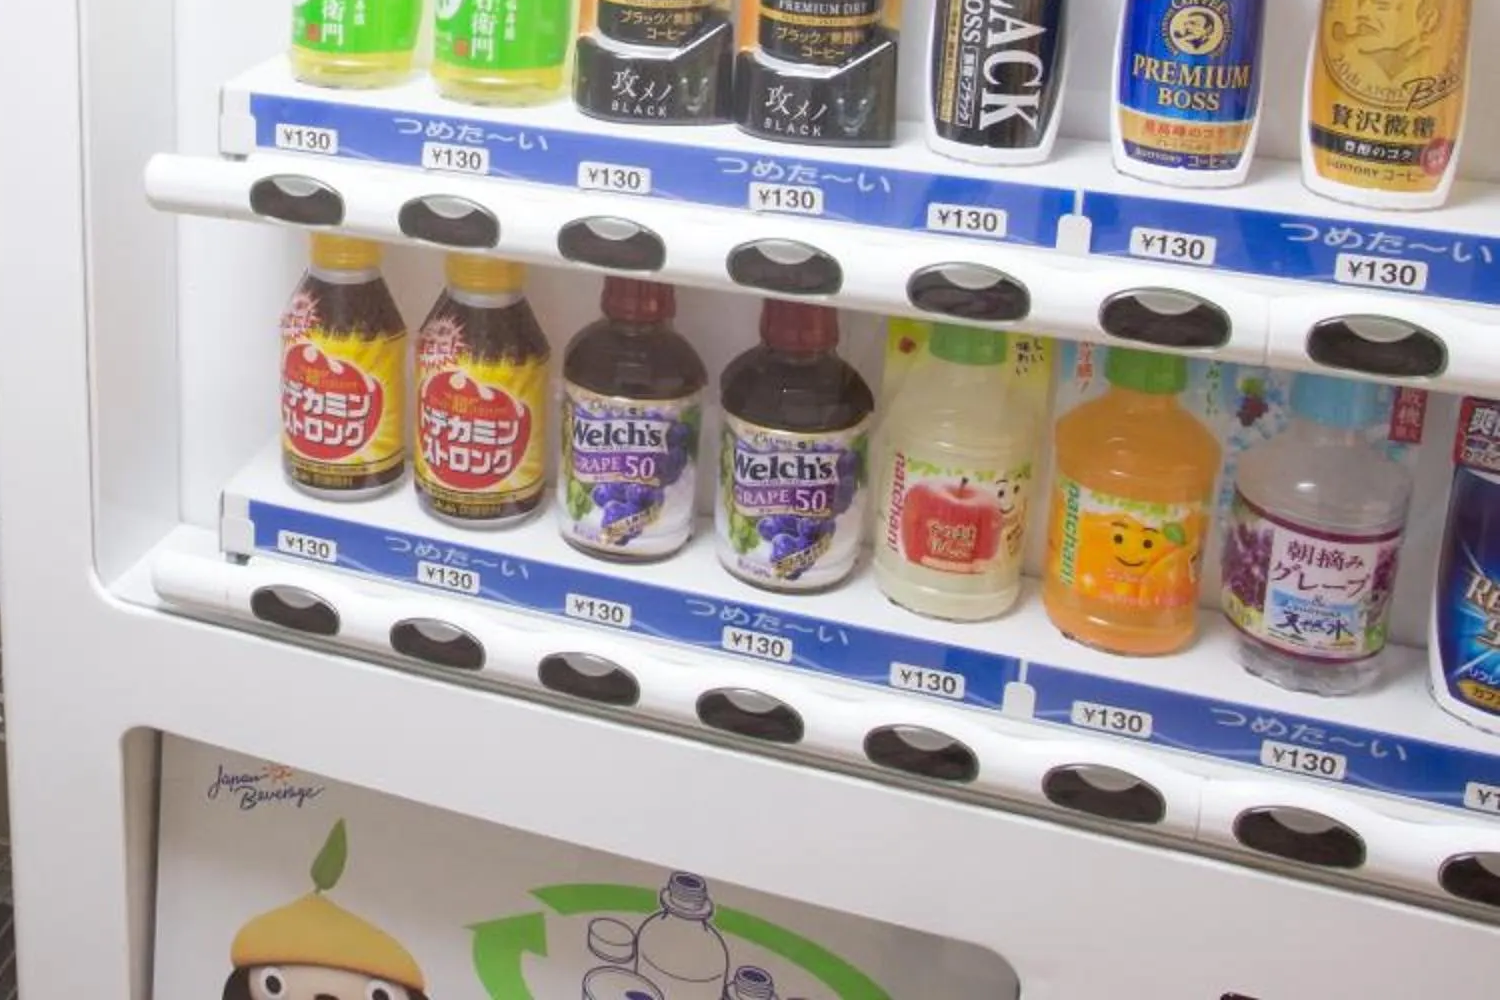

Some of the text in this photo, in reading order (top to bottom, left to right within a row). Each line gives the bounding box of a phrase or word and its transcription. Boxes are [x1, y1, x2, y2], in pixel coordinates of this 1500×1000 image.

[1132, 53, 1251, 89] PREMIUM
[611, 102, 668, 118] BLACK
[1158, 87, 1220, 111] BOSS
[283, 128, 331, 150] ¥130
[764, 118, 822, 137] BLACK
[431, 149, 482, 171] ¥130
[587, 167, 641, 190] ¥130
[758, 187, 815, 210] ¥130
[936, 207, 998, 233] ¥130
[1141, 232, 1205, 261] ¥130
[1348, 260, 1418, 287] ¥130
[573, 420, 662, 447] Welch's
[624, 455, 655, 480] 50
[735, 453, 833, 481] Welch's
[795, 489, 827, 513] 50
[285, 535, 330, 559] ¥130
[1287, 541, 1365, 573] 朝摘み
[424, 566, 474, 590] ¥130
[1271, 560, 1371, 599] グレープ
[573, 598, 624, 624] ¥130
[731, 632, 785, 658] ¥130
[901, 668, 957, 695] ¥130
[1082, 707, 1144, 734] ¥130
[1272, 746, 1337, 775] ¥130
